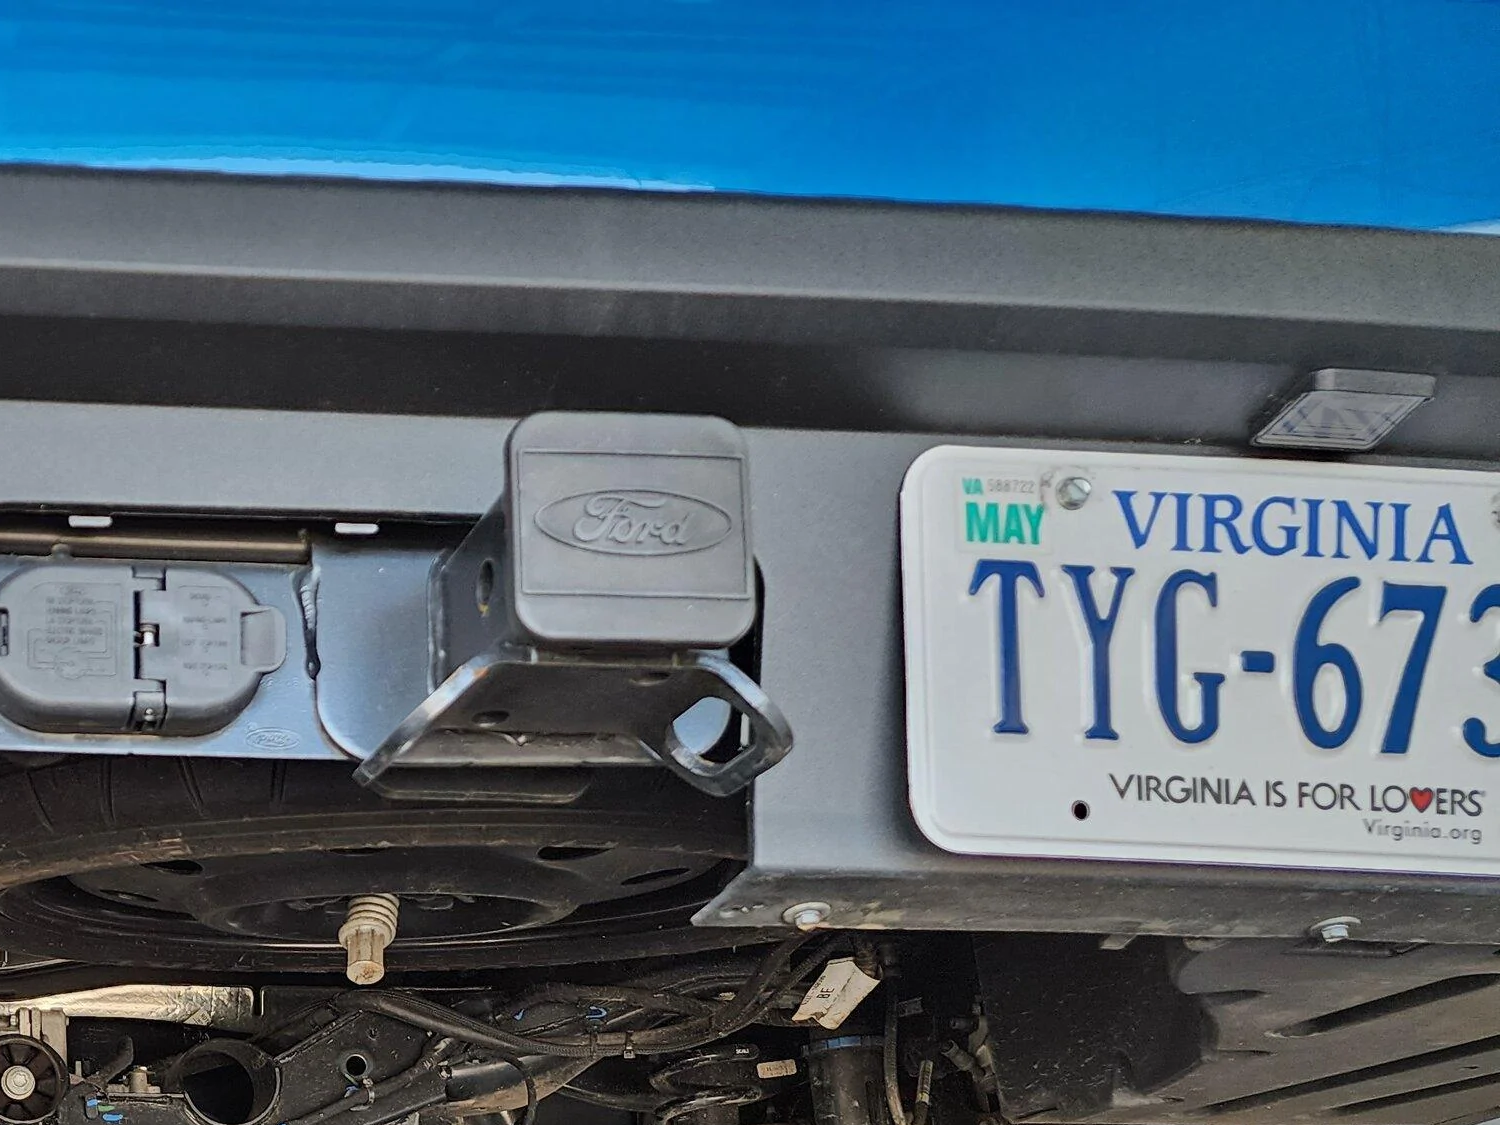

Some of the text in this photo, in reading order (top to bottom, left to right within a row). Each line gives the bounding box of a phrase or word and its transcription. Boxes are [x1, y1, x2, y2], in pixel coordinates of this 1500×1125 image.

[962, 477, 983, 495] VA
[572, 496, 695, 546] Ford
[965, 501, 1045, 545] MAY
[1111, 489, 1473, 565] VIRGINIA
[1108, 773, 1257, 807] VIRGINIA
[1265, 780, 1287, 808] IS
[1297, 782, 1362, 811] FOR
[1362, 817, 1483, 845] Virginia.org
